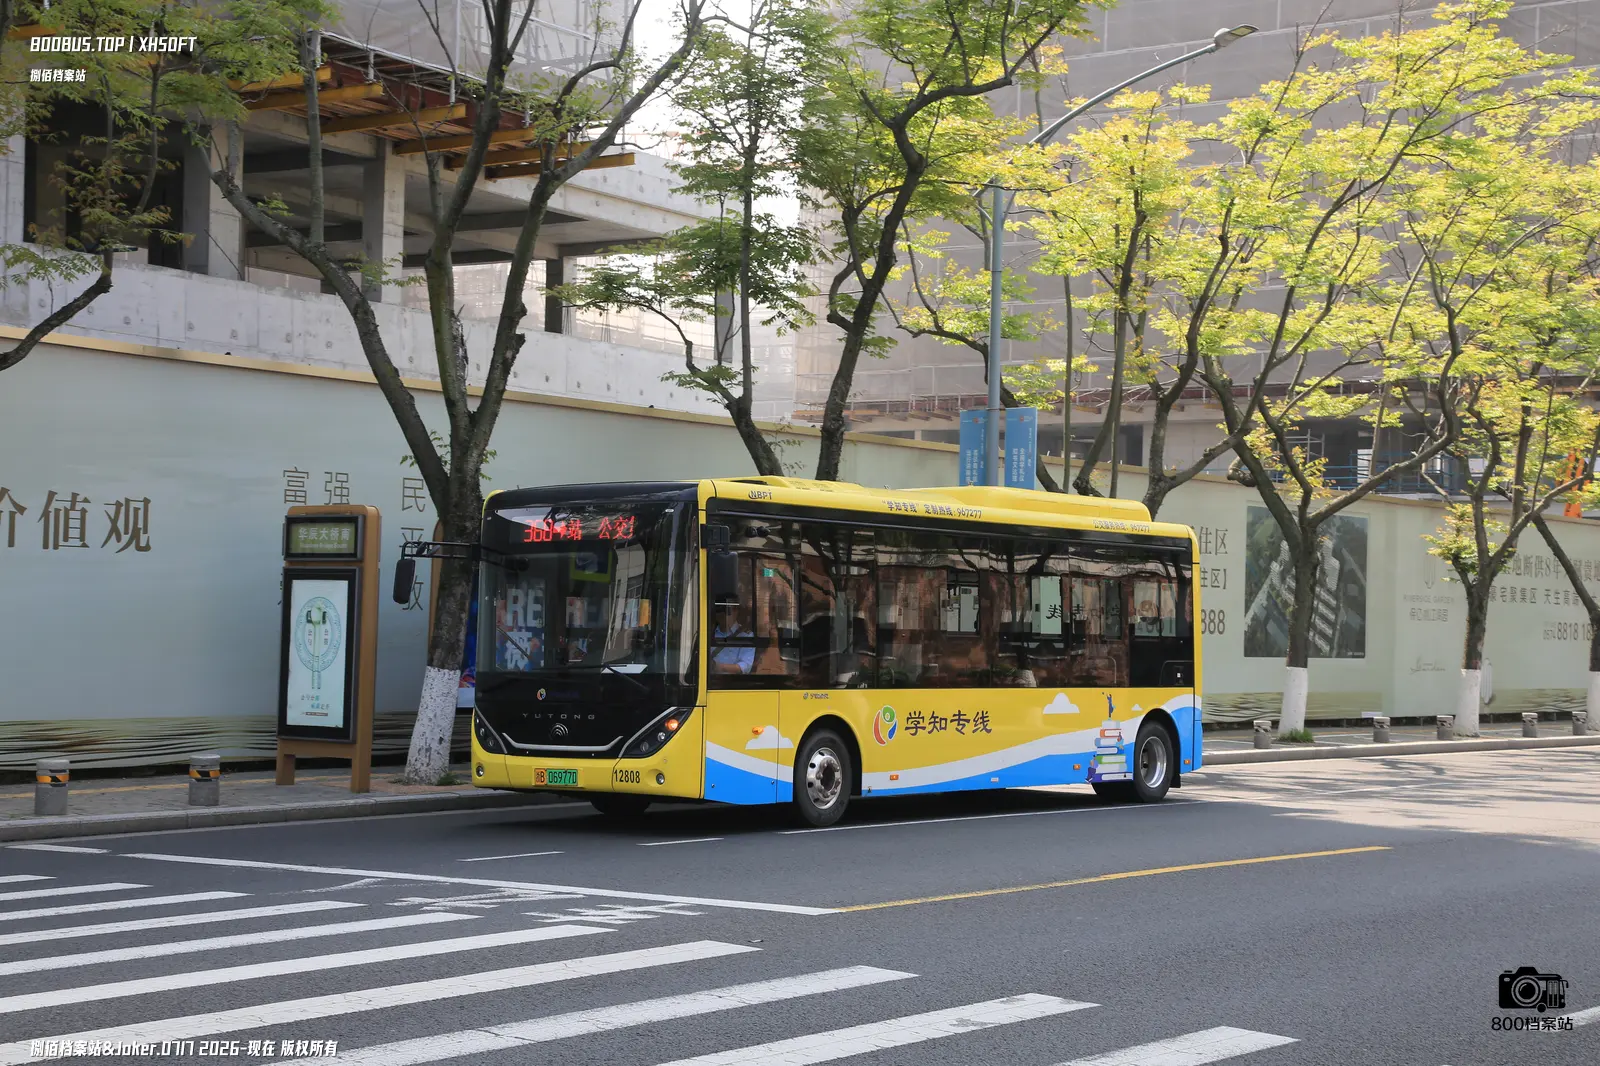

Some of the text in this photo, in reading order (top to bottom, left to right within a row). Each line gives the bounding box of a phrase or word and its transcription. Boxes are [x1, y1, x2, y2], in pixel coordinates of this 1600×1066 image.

[283, 466, 350, 505] 富强
[904, 709, 992, 736] 学知专线
[613, 769, 641, 784] 12808
